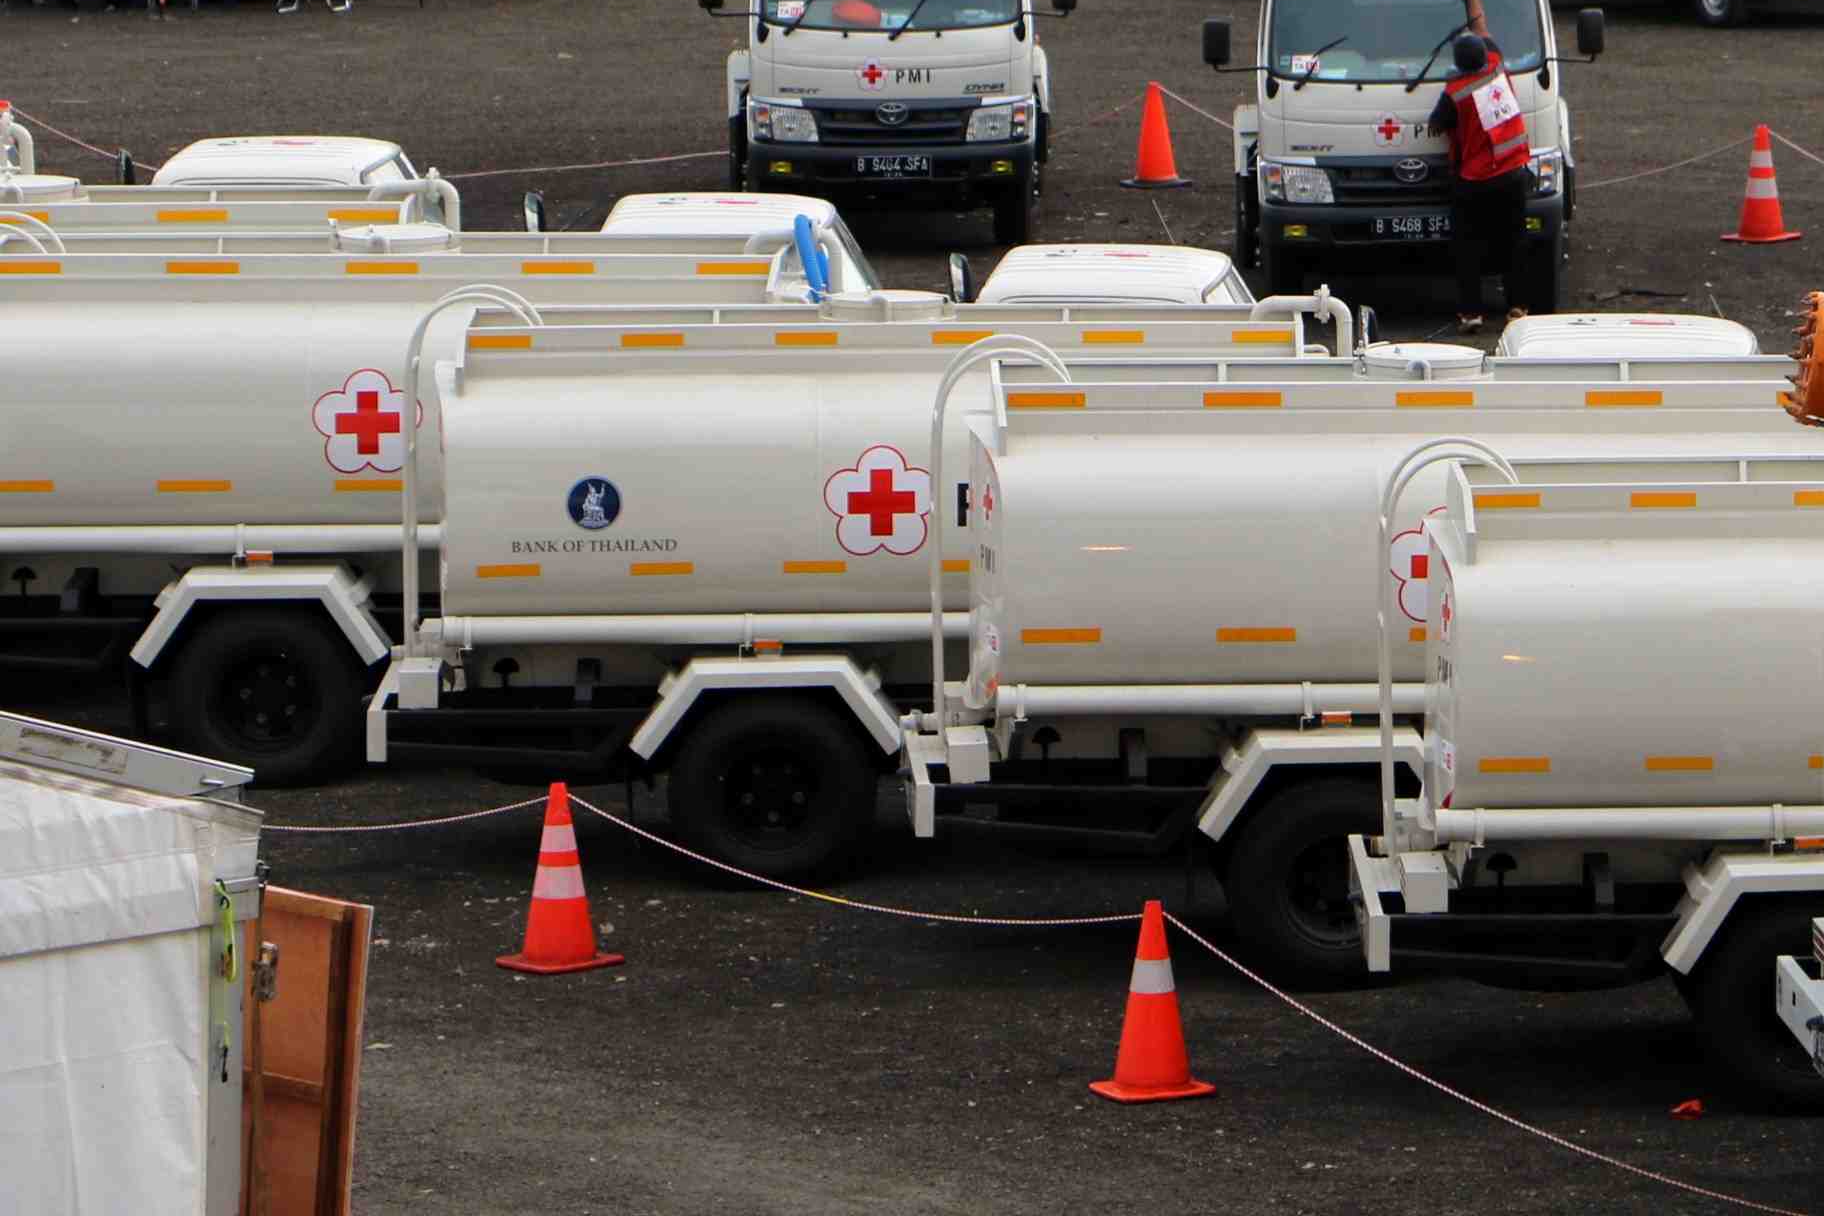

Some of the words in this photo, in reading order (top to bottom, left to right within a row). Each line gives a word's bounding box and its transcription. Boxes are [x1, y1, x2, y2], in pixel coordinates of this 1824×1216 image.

[896, 68, 931, 84] PMI
[857, 158, 865, 172] B
[1376, 218, 1385, 233] B
[511, 541, 558, 553] BANK
[562, 540, 585, 552] OF
[589, 538, 678, 552] THAILAND
